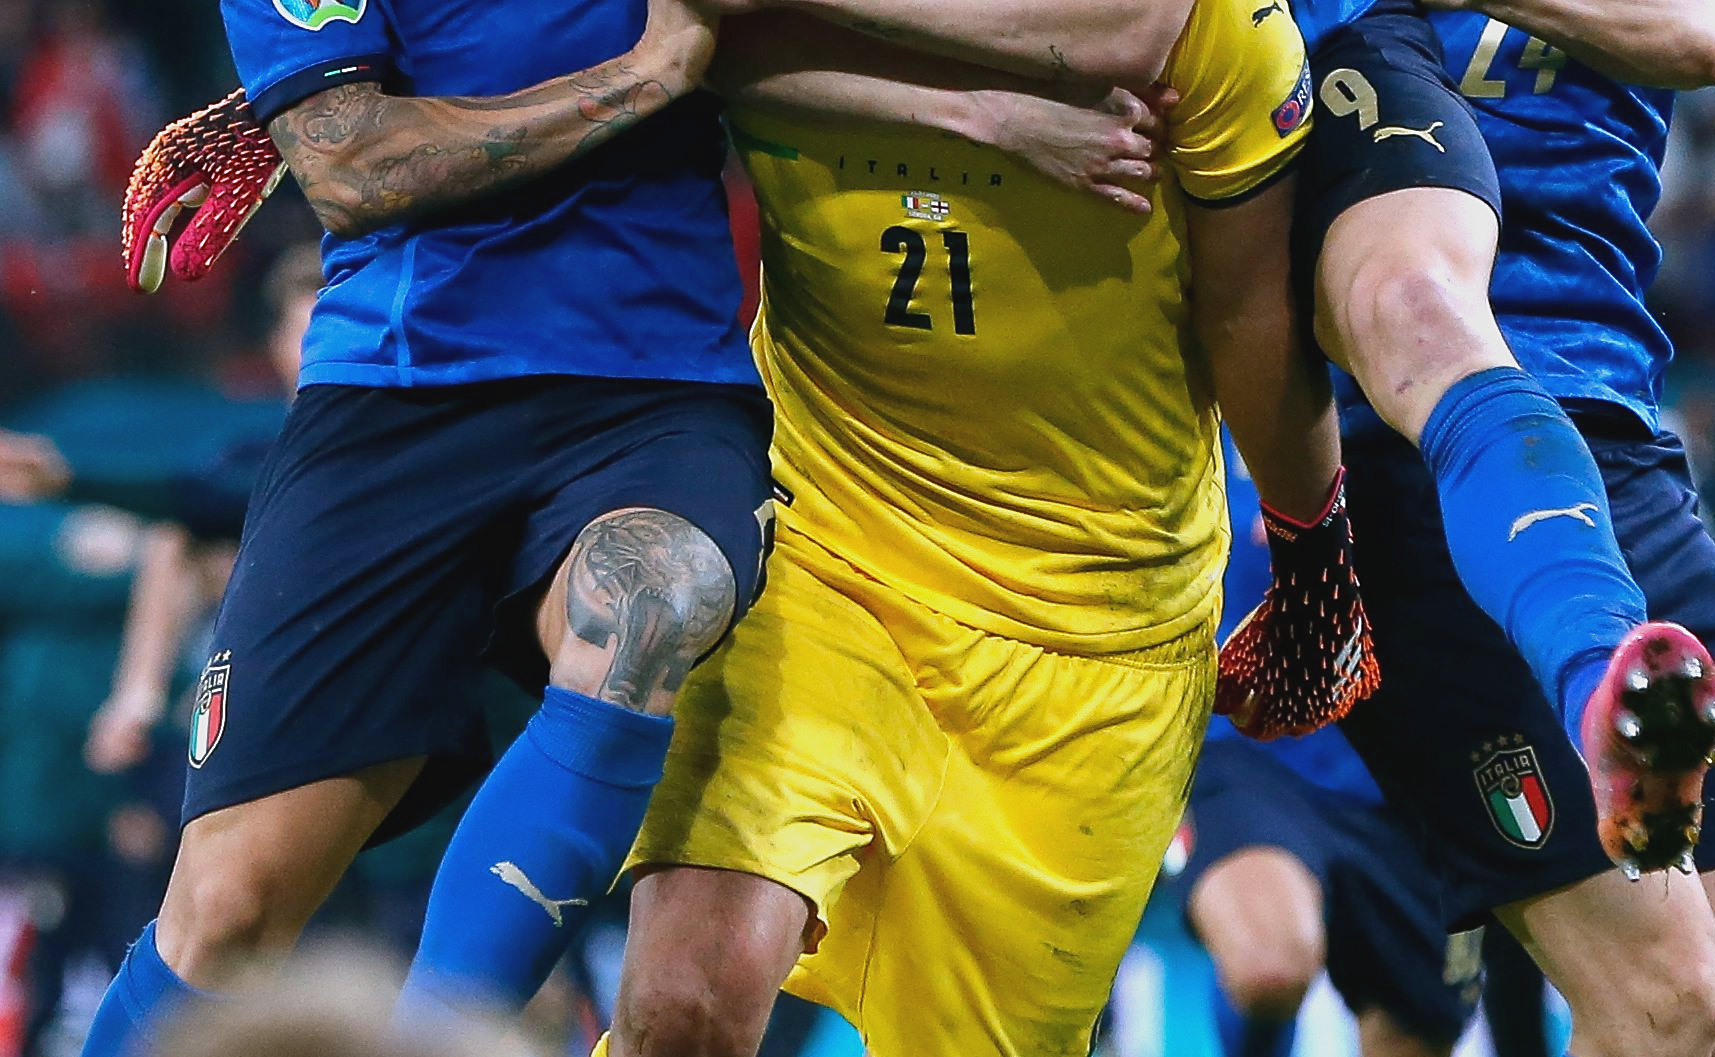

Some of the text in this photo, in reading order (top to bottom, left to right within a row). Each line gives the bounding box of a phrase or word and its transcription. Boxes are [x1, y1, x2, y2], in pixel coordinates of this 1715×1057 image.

[1319, 68, 1379, 131] 9
[838, 155, 1002, 187] ITALIA
[880, 225, 976, 335] 21
[1481, 754, 1530, 786] ITALIA
